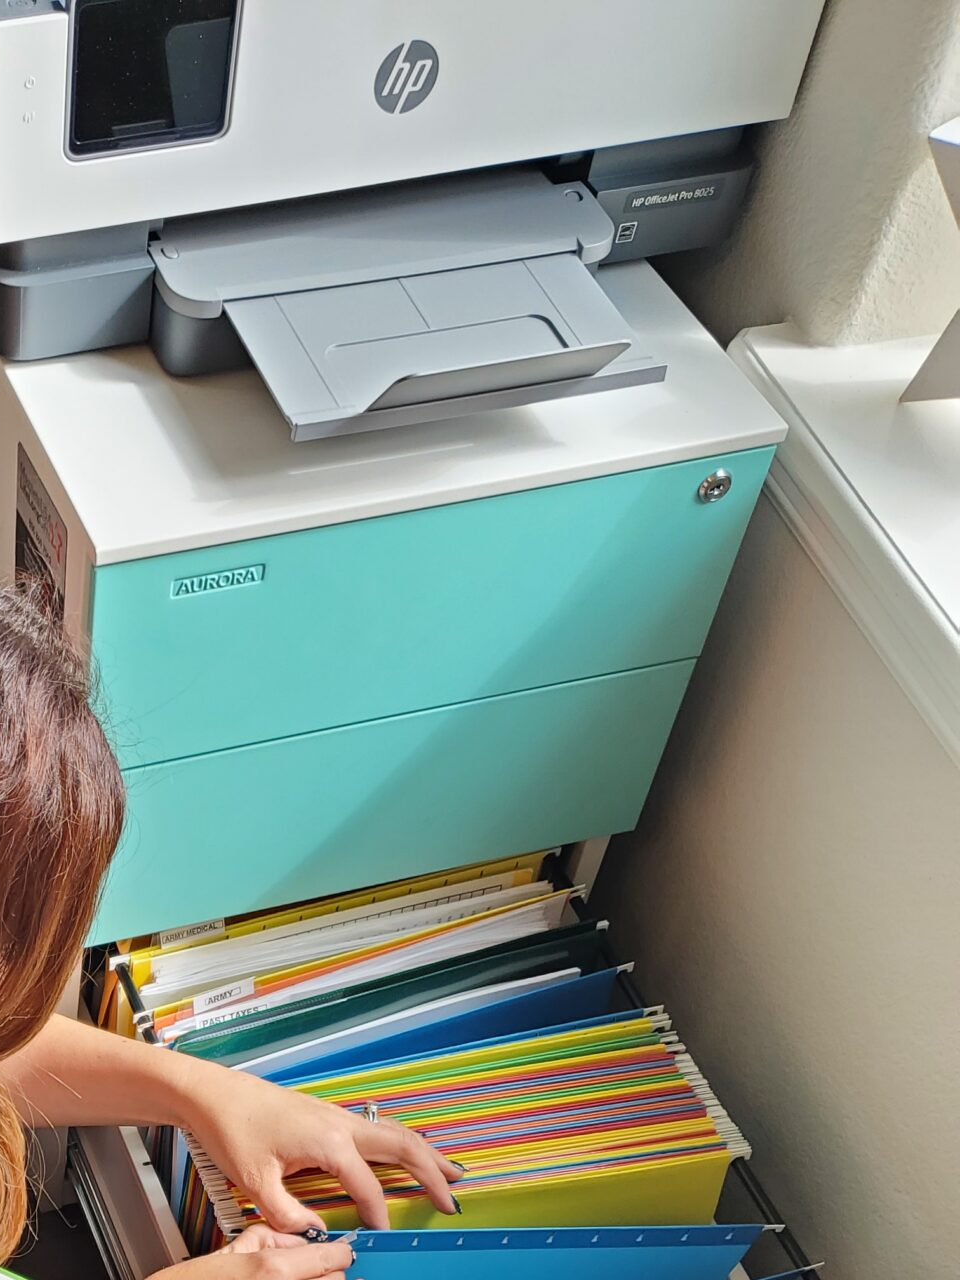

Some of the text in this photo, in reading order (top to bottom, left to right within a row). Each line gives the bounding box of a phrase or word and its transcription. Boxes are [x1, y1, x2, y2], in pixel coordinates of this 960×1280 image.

[380, 40, 433, 114] hp
[631, 186, 716, 208] HP OfficeJet Pro 8025
[175, 566, 259, 597] AURORA
[164, 922, 219, 943] ARMY MEDICAL
[207, 990, 234, 1005] ARMY
[202, 1006, 260, 1027] PAST TAXES
